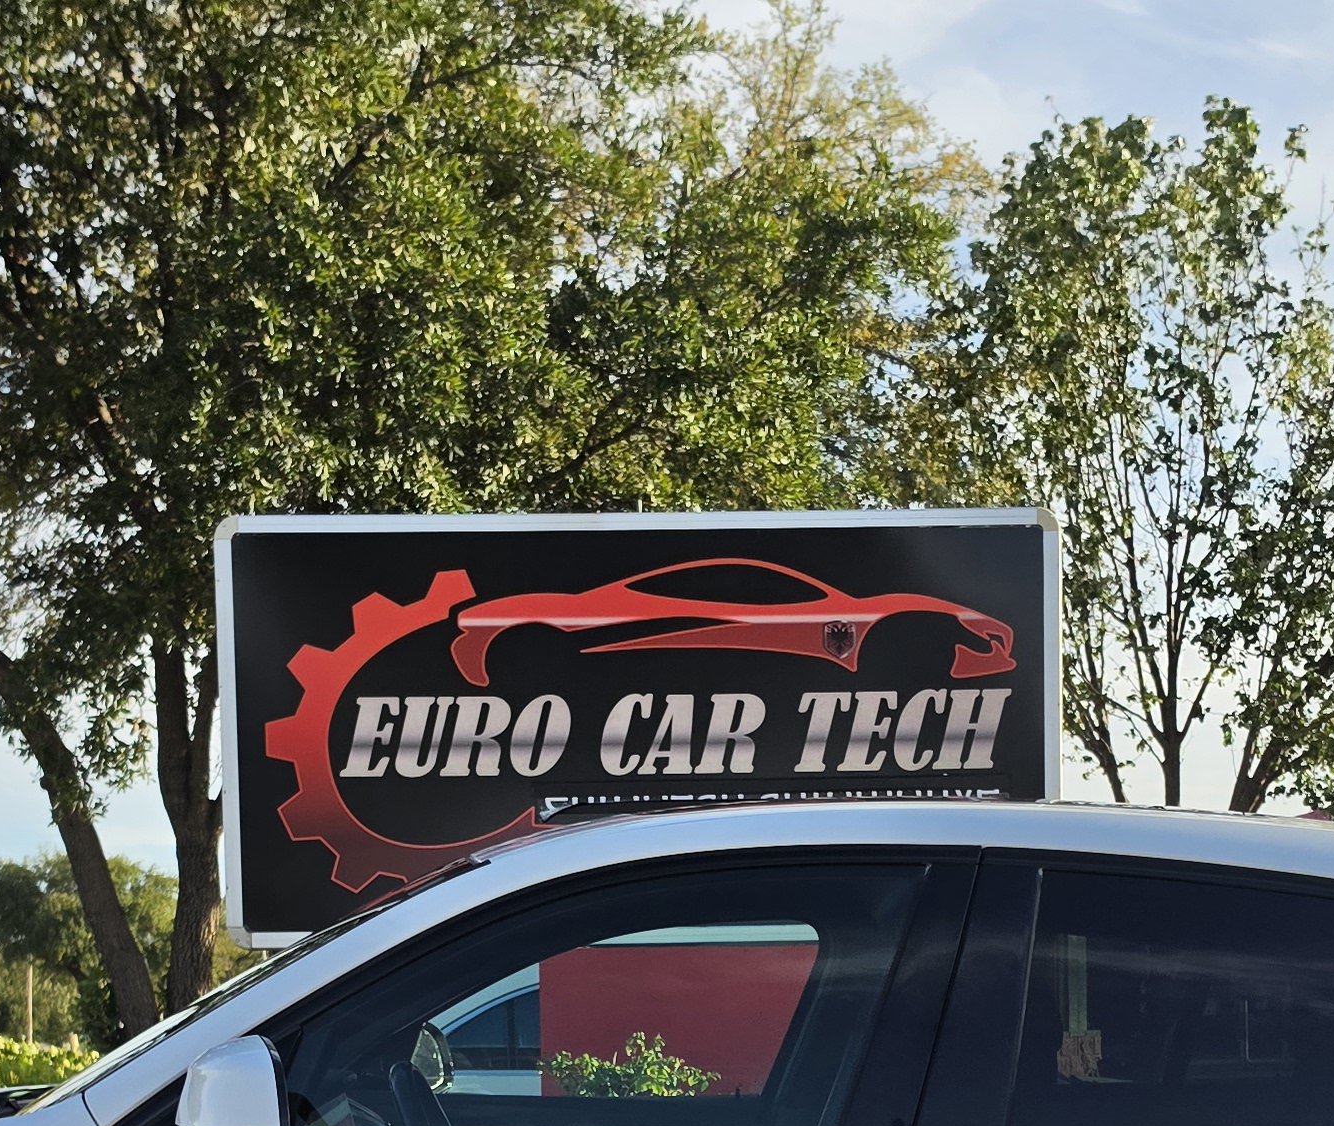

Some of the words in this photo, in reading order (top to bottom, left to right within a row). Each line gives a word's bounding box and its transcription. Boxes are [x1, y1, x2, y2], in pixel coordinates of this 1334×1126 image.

[339, 694, 572, 778] EURO
[599, 691, 766, 777] CAR
[793, 688, 1013, 774] TECH
